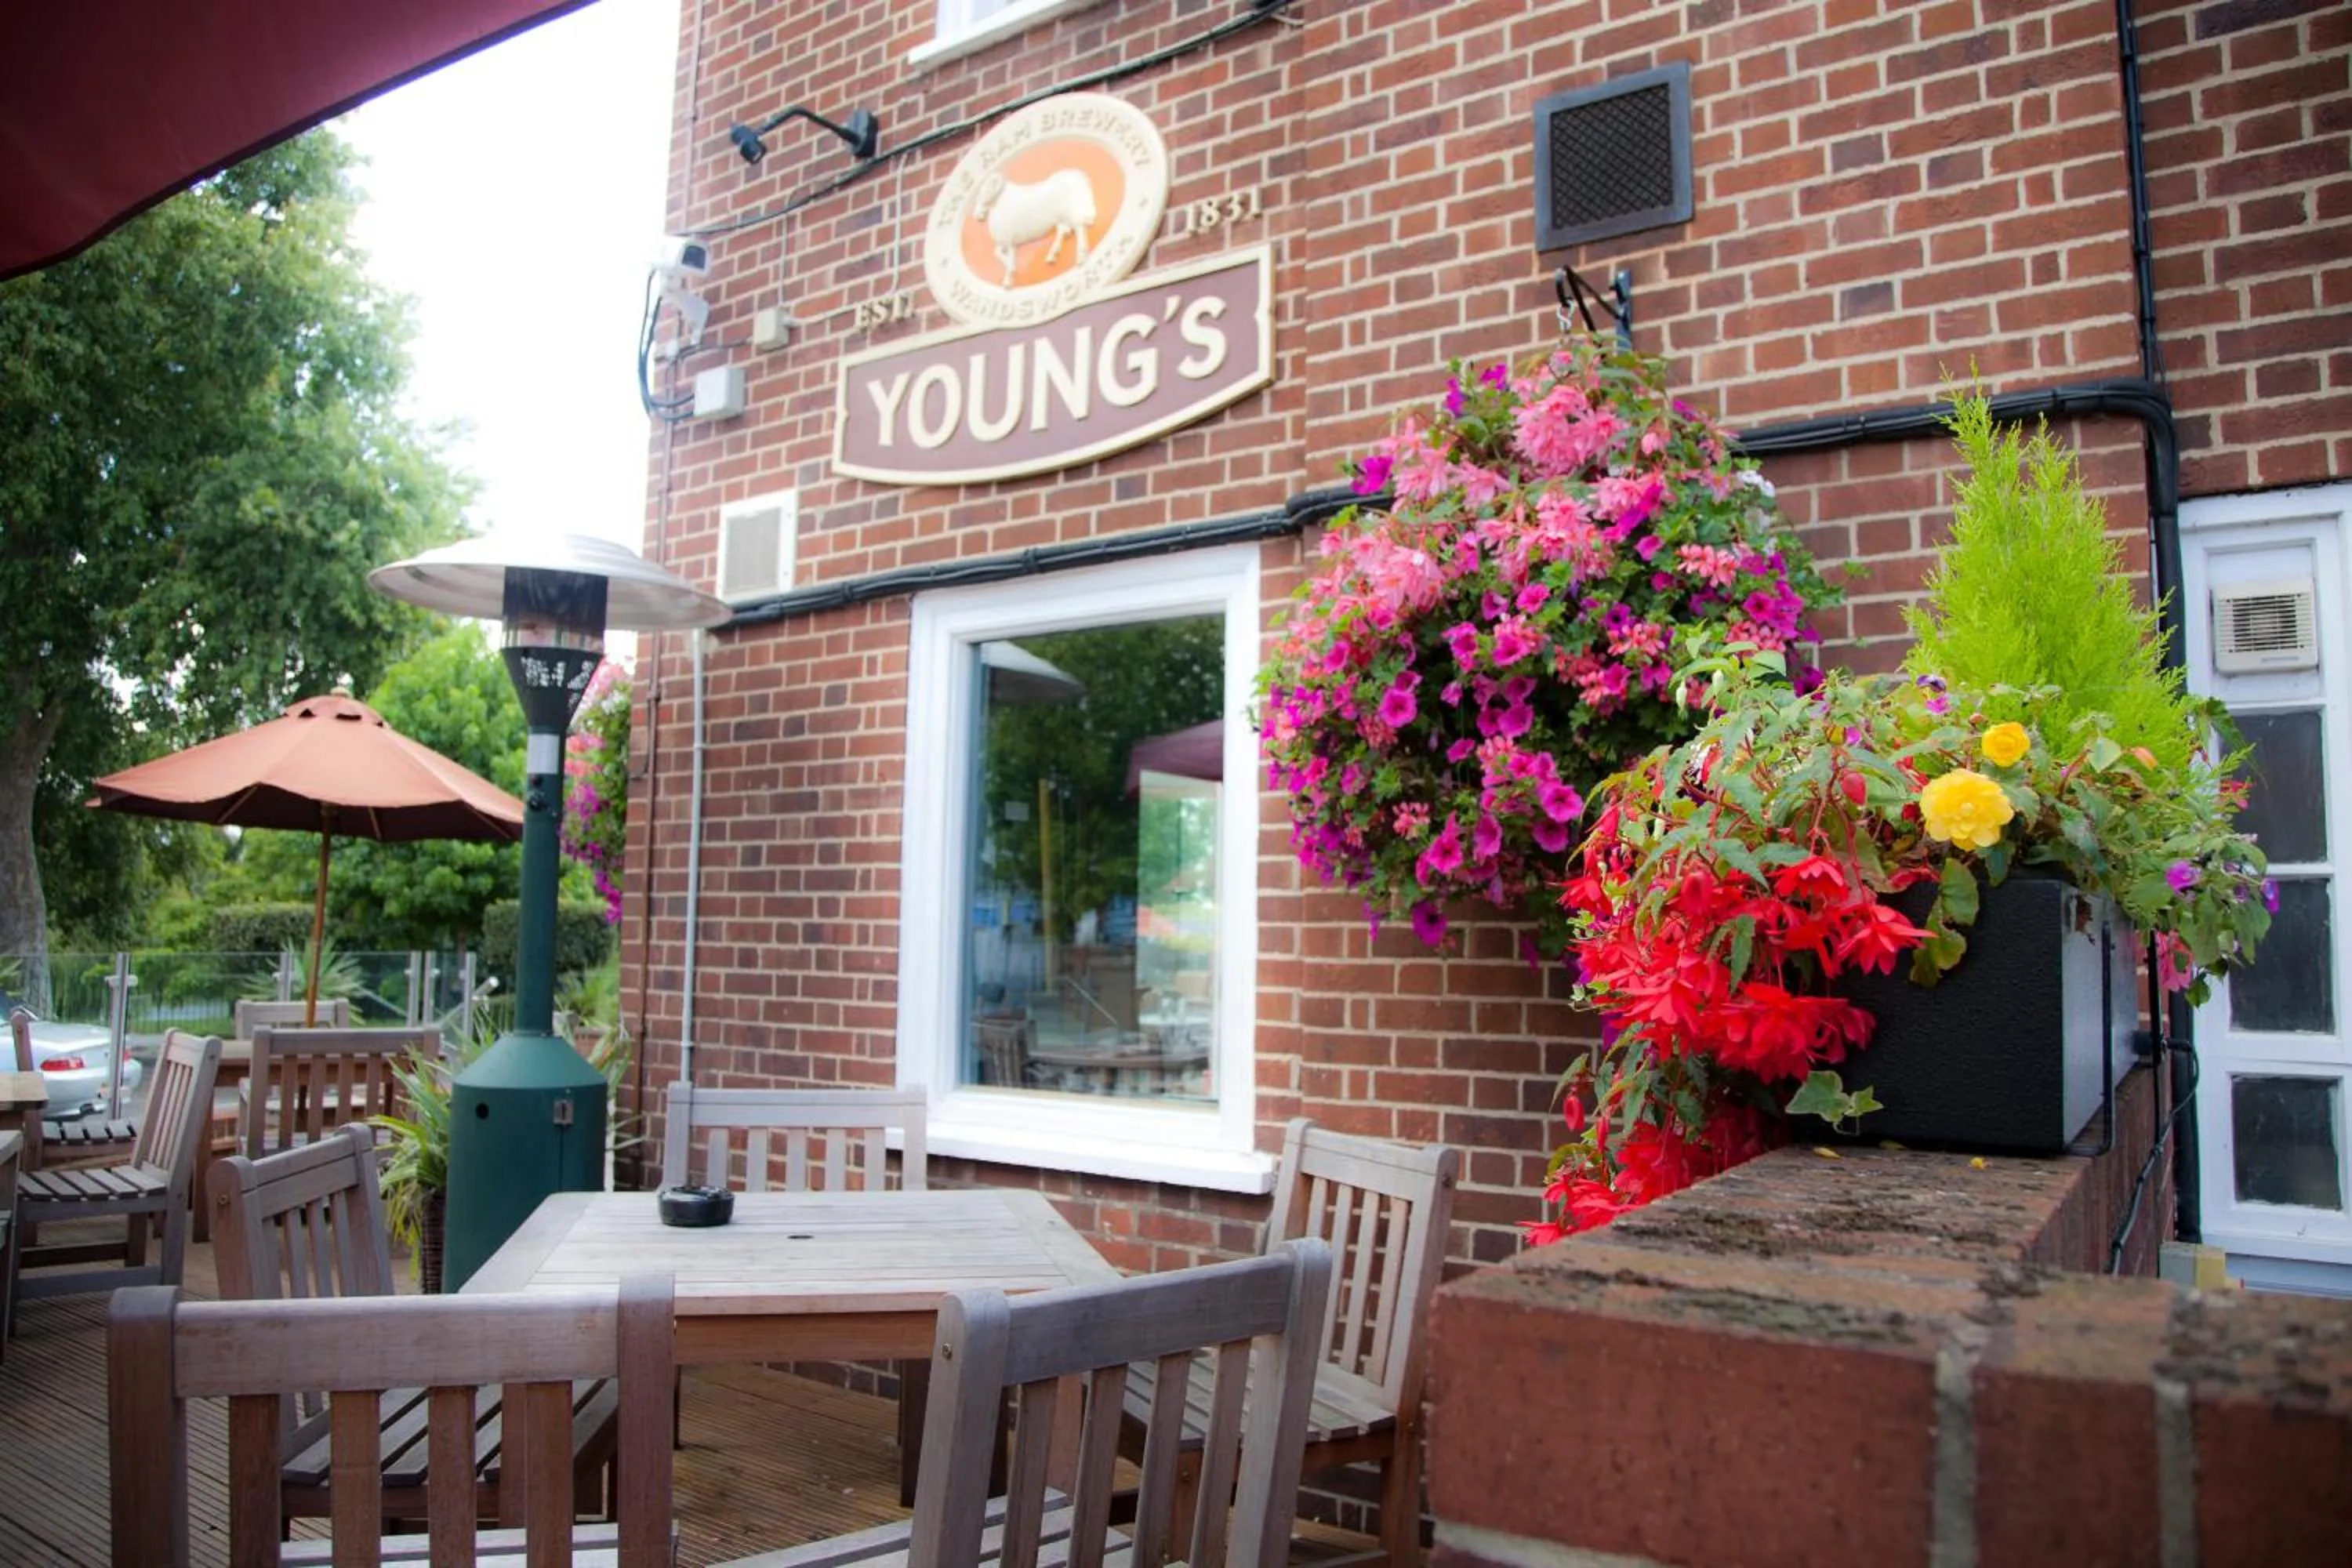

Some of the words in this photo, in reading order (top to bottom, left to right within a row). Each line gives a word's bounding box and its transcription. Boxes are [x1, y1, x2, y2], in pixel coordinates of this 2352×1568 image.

[979, 120, 1032, 171] RAM
[1040, 107, 1151, 166] BREWERY
[1183, 185, 1261, 234] 1831
[867, 294, 1227, 449] YOUNG'S
